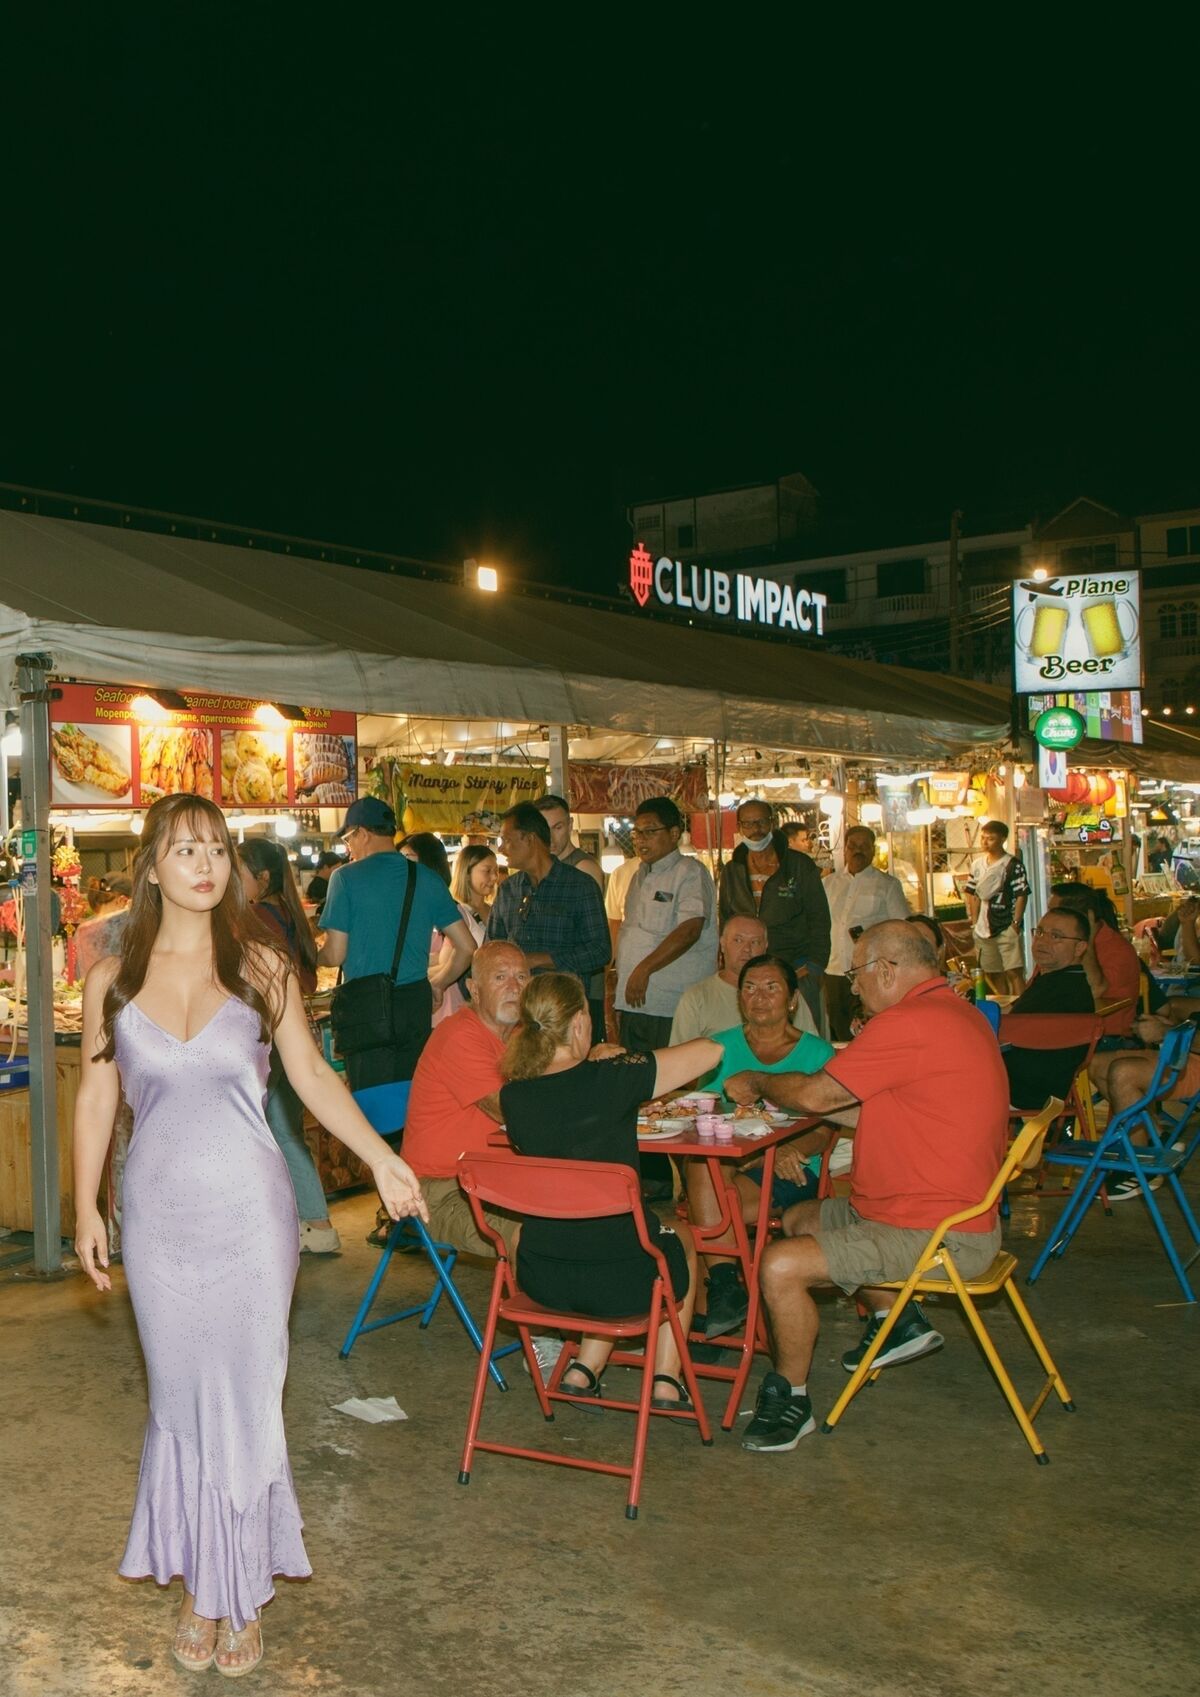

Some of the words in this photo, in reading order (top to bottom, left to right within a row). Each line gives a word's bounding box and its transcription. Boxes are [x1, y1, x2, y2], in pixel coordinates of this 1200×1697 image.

[655, 556, 731, 615] CLUB
[737, 573, 827, 636] IMPACT
[1065, 577, 1130, 600] Plane
[1039, 655, 1117, 680] Beer
[95, 707, 136, 720] Морепро
[200, 714, 258, 725] приготовлен
[1041, 726, 1078, 740] Chang
[408, 774, 460, 794] Mango
